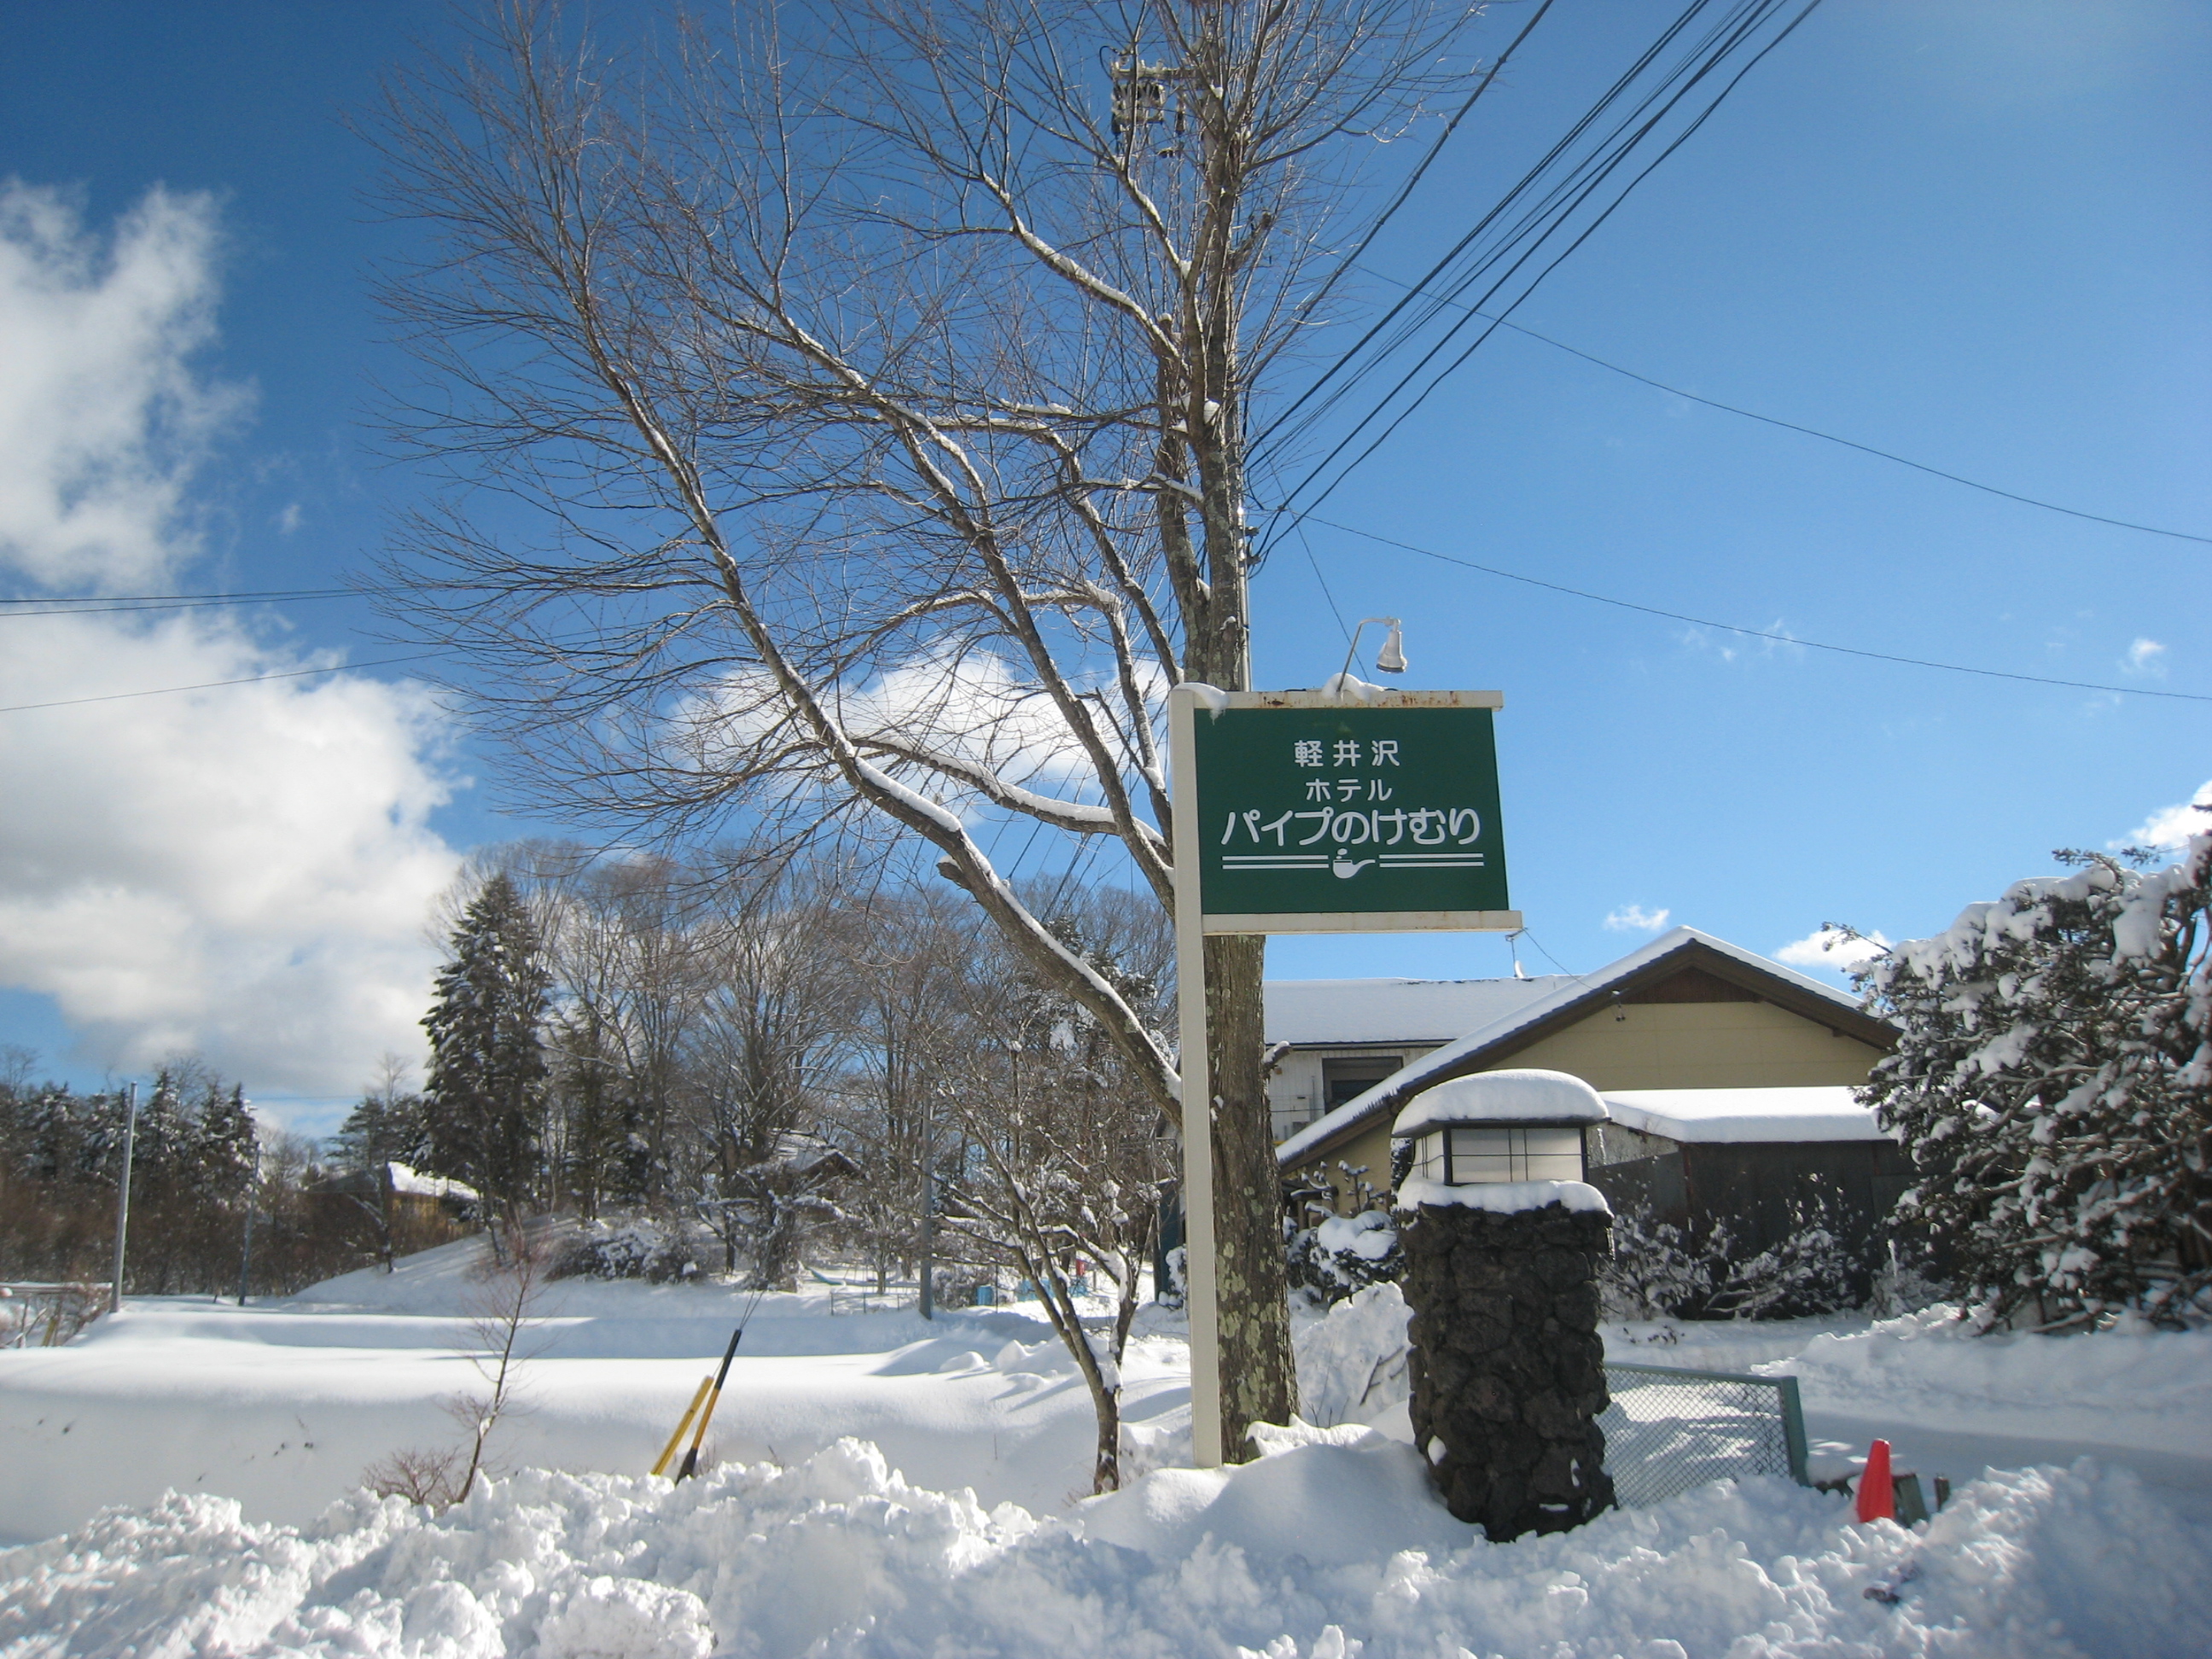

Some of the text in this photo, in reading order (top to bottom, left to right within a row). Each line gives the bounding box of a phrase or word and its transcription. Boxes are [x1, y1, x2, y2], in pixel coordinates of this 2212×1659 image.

[1294, 739, 1400, 767] 軽井沢
[1306, 778, 1393, 802] ホテル
[1220, 806, 1481, 847] パイプのけむり
